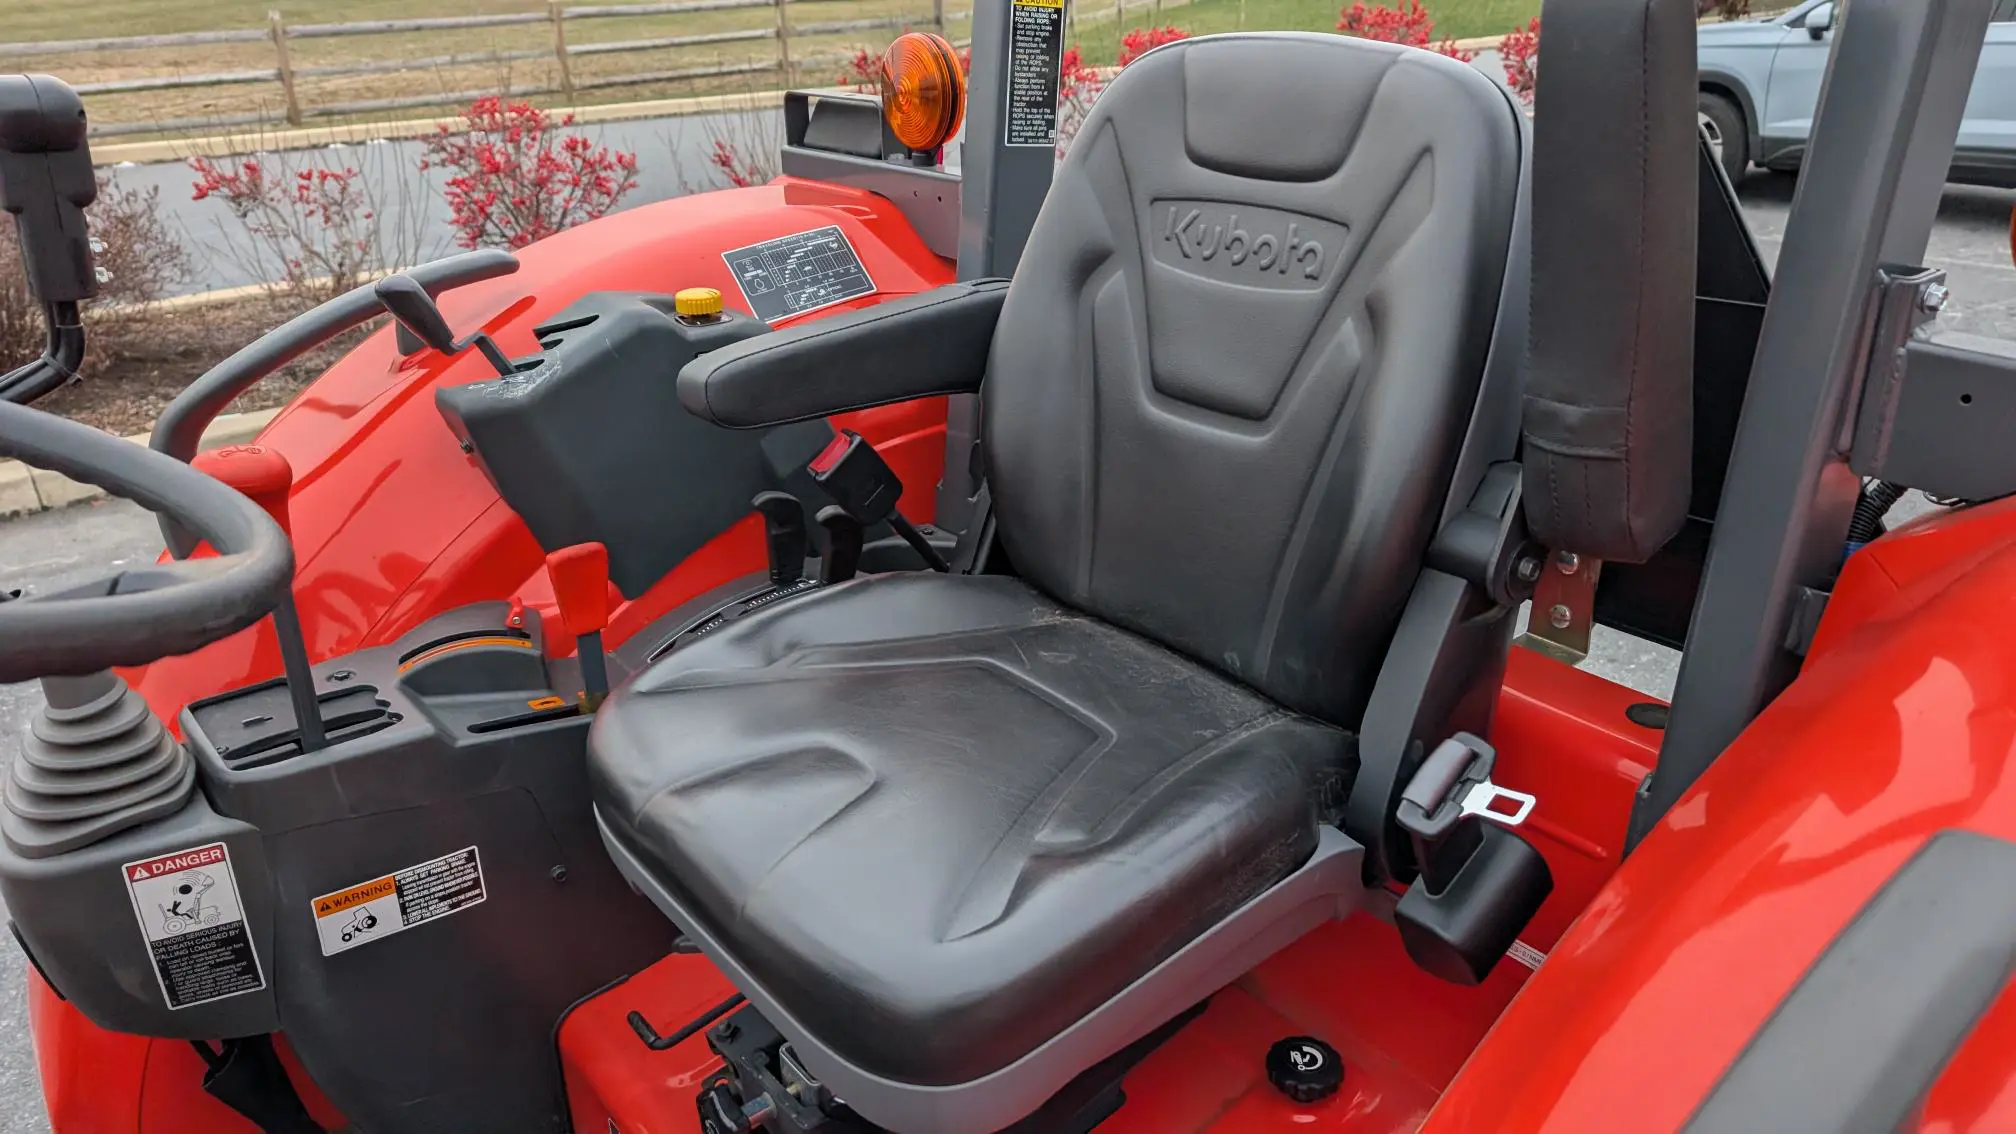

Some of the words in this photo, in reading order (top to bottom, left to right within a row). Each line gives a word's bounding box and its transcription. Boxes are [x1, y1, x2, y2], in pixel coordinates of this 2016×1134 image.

[1165, 206, 1324, 281] Kubota
[151, 849, 222, 874] DANGER
[333, 882, 392, 907] WARNING
[153, 946, 166, 954] OR
[167, 940, 194, 950] DEATH
[194, 931, 228, 944] CAUSED
[228, 928, 240, 936] BY
[162, 935, 184, 945] AVOID
[185, 927, 217, 939] SERIOUS
[217, 920, 242, 931] INJURY
[154, 948, 188, 961] FALLING
